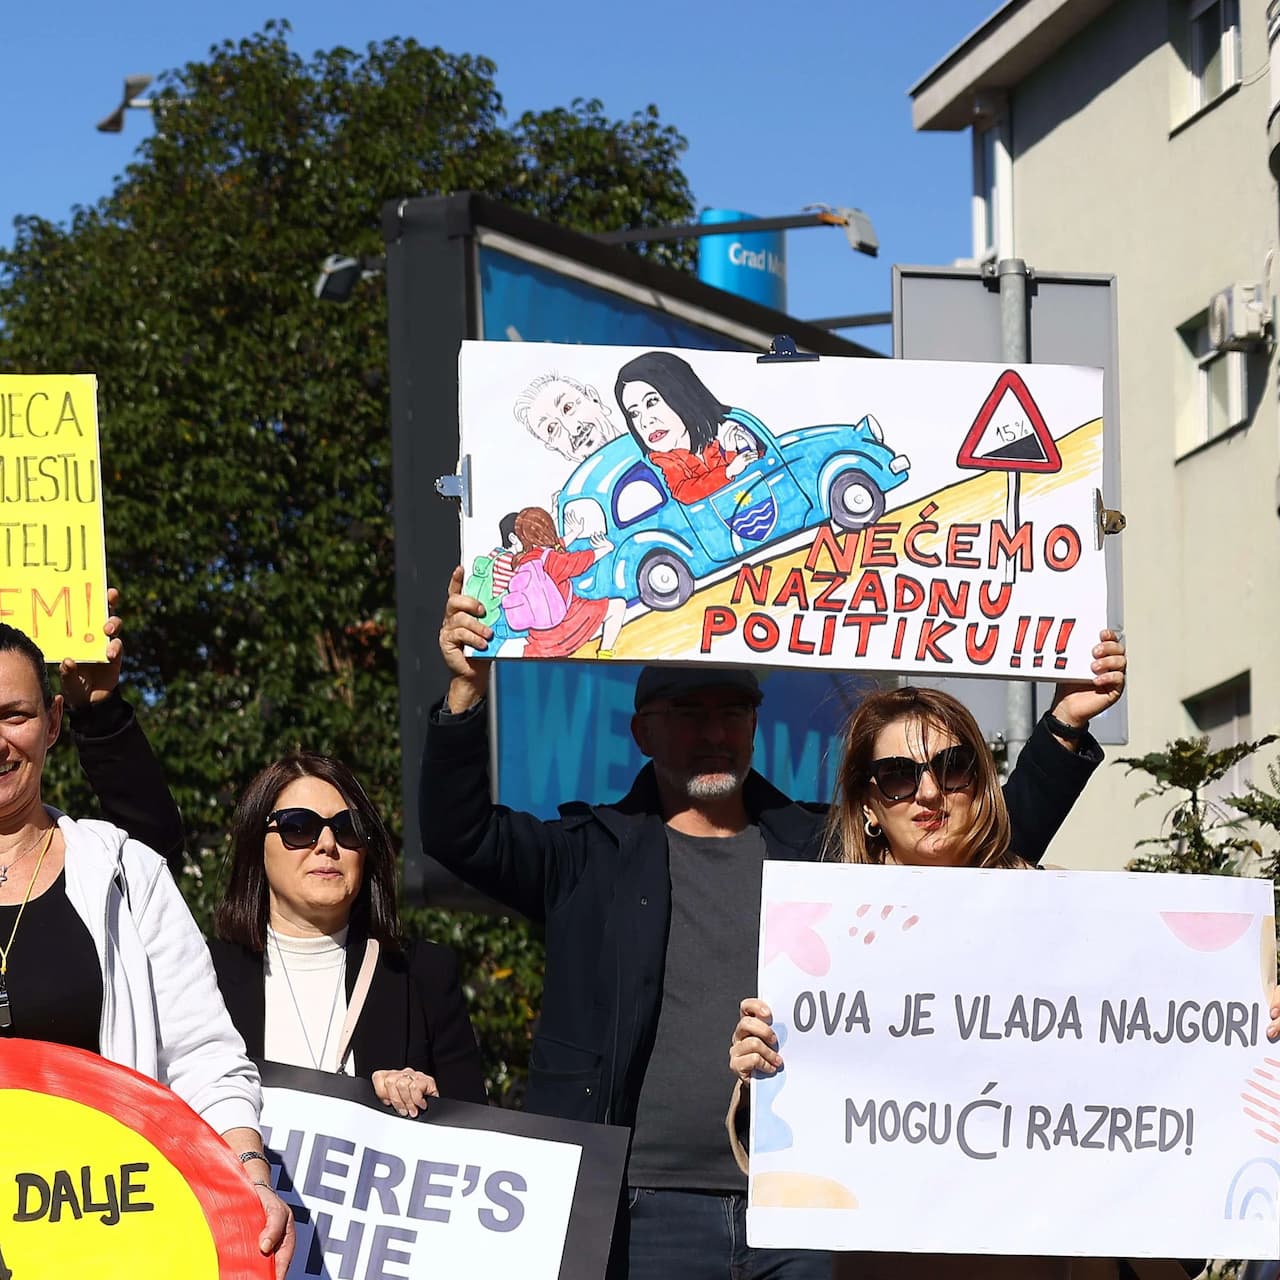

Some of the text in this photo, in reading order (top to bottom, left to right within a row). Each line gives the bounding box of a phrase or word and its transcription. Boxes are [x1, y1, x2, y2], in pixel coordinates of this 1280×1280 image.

[995, 421, 1028, 443] 15%
[805, 500, 1081, 576] NEĆEMO
[731, 564, 1012, 619] NAZADNU
[700, 606, 1075, 669] POLITIKU!!!
[794, 991, 1259, 1047] OVA JE VLADA NAJGORI
[846, 1082, 1193, 1159] MOGUĆI RAZRED!
[14, 1163, 153, 1225] DALJE
